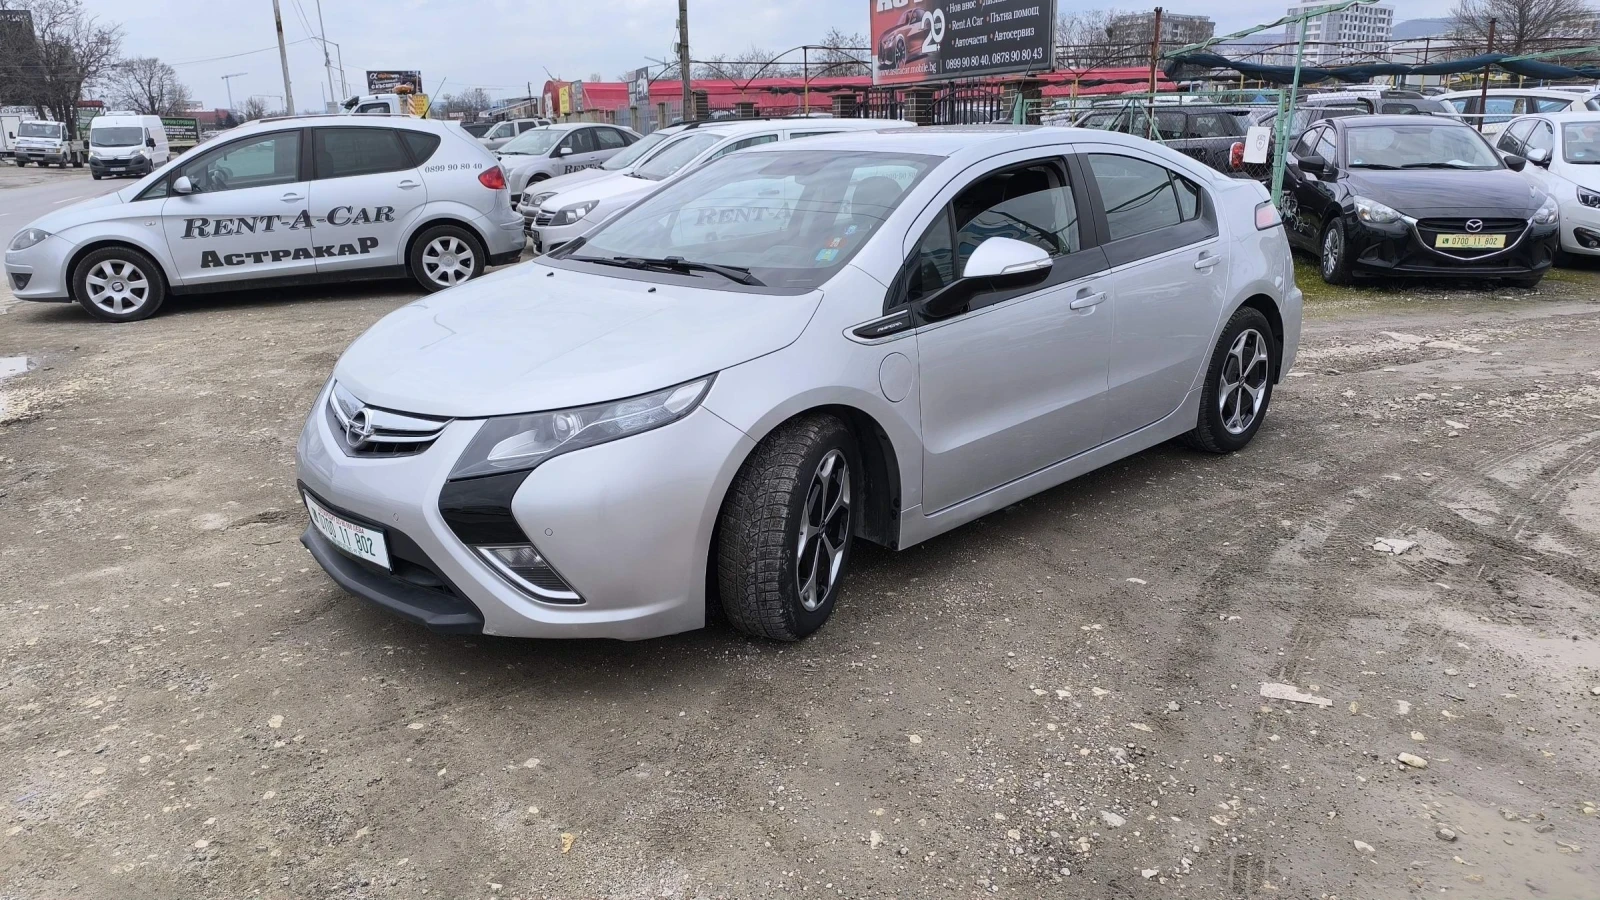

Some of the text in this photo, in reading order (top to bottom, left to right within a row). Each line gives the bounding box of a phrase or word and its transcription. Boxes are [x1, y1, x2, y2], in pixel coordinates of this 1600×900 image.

[950, 1, 976, 13] Нов внос
[990, 6, 1039, 23] Пътна помощ
[951, 20, 965, 30] Rent
[966, 18, 972, 28] A
[972, 16, 984, 27] Car
[994, 28, 1035, 41] Автосервиз
[955, 35, 987, 48] Авточасти
[945, 57, 961, 69] 0899
[961, 57, 970, 68] 90
[970, 56, 979, 67] 80
[991, 52, 1010, 64] 0878
[1010, 50, 1020, 62] 90
[1021, 49, 1031, 61] 80
[1032, 47, 1042, 60] 43
[425, 164, 446, 173] 0899
[1452, 237, 1498, 245] 0700 11 802
[339, 525, 351, 546] 11
[354, 532, 376, 556] 802
